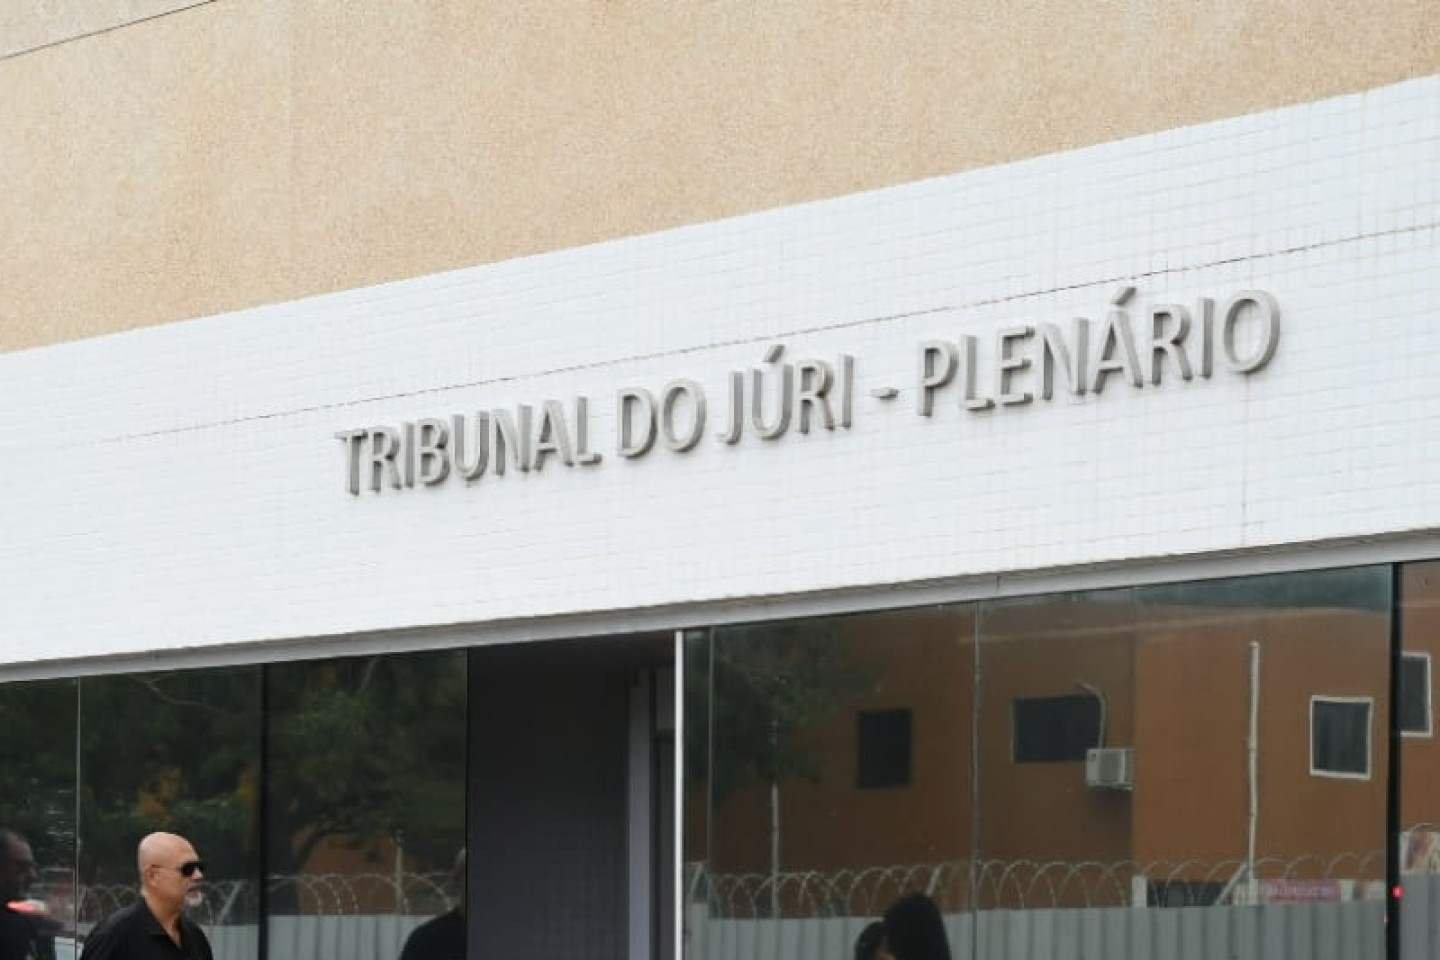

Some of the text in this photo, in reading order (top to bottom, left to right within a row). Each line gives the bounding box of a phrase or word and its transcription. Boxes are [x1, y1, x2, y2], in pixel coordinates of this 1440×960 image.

[334, 286, 1281, 496] TRIBUNAL DO JÚRI - PLENÁRIO
